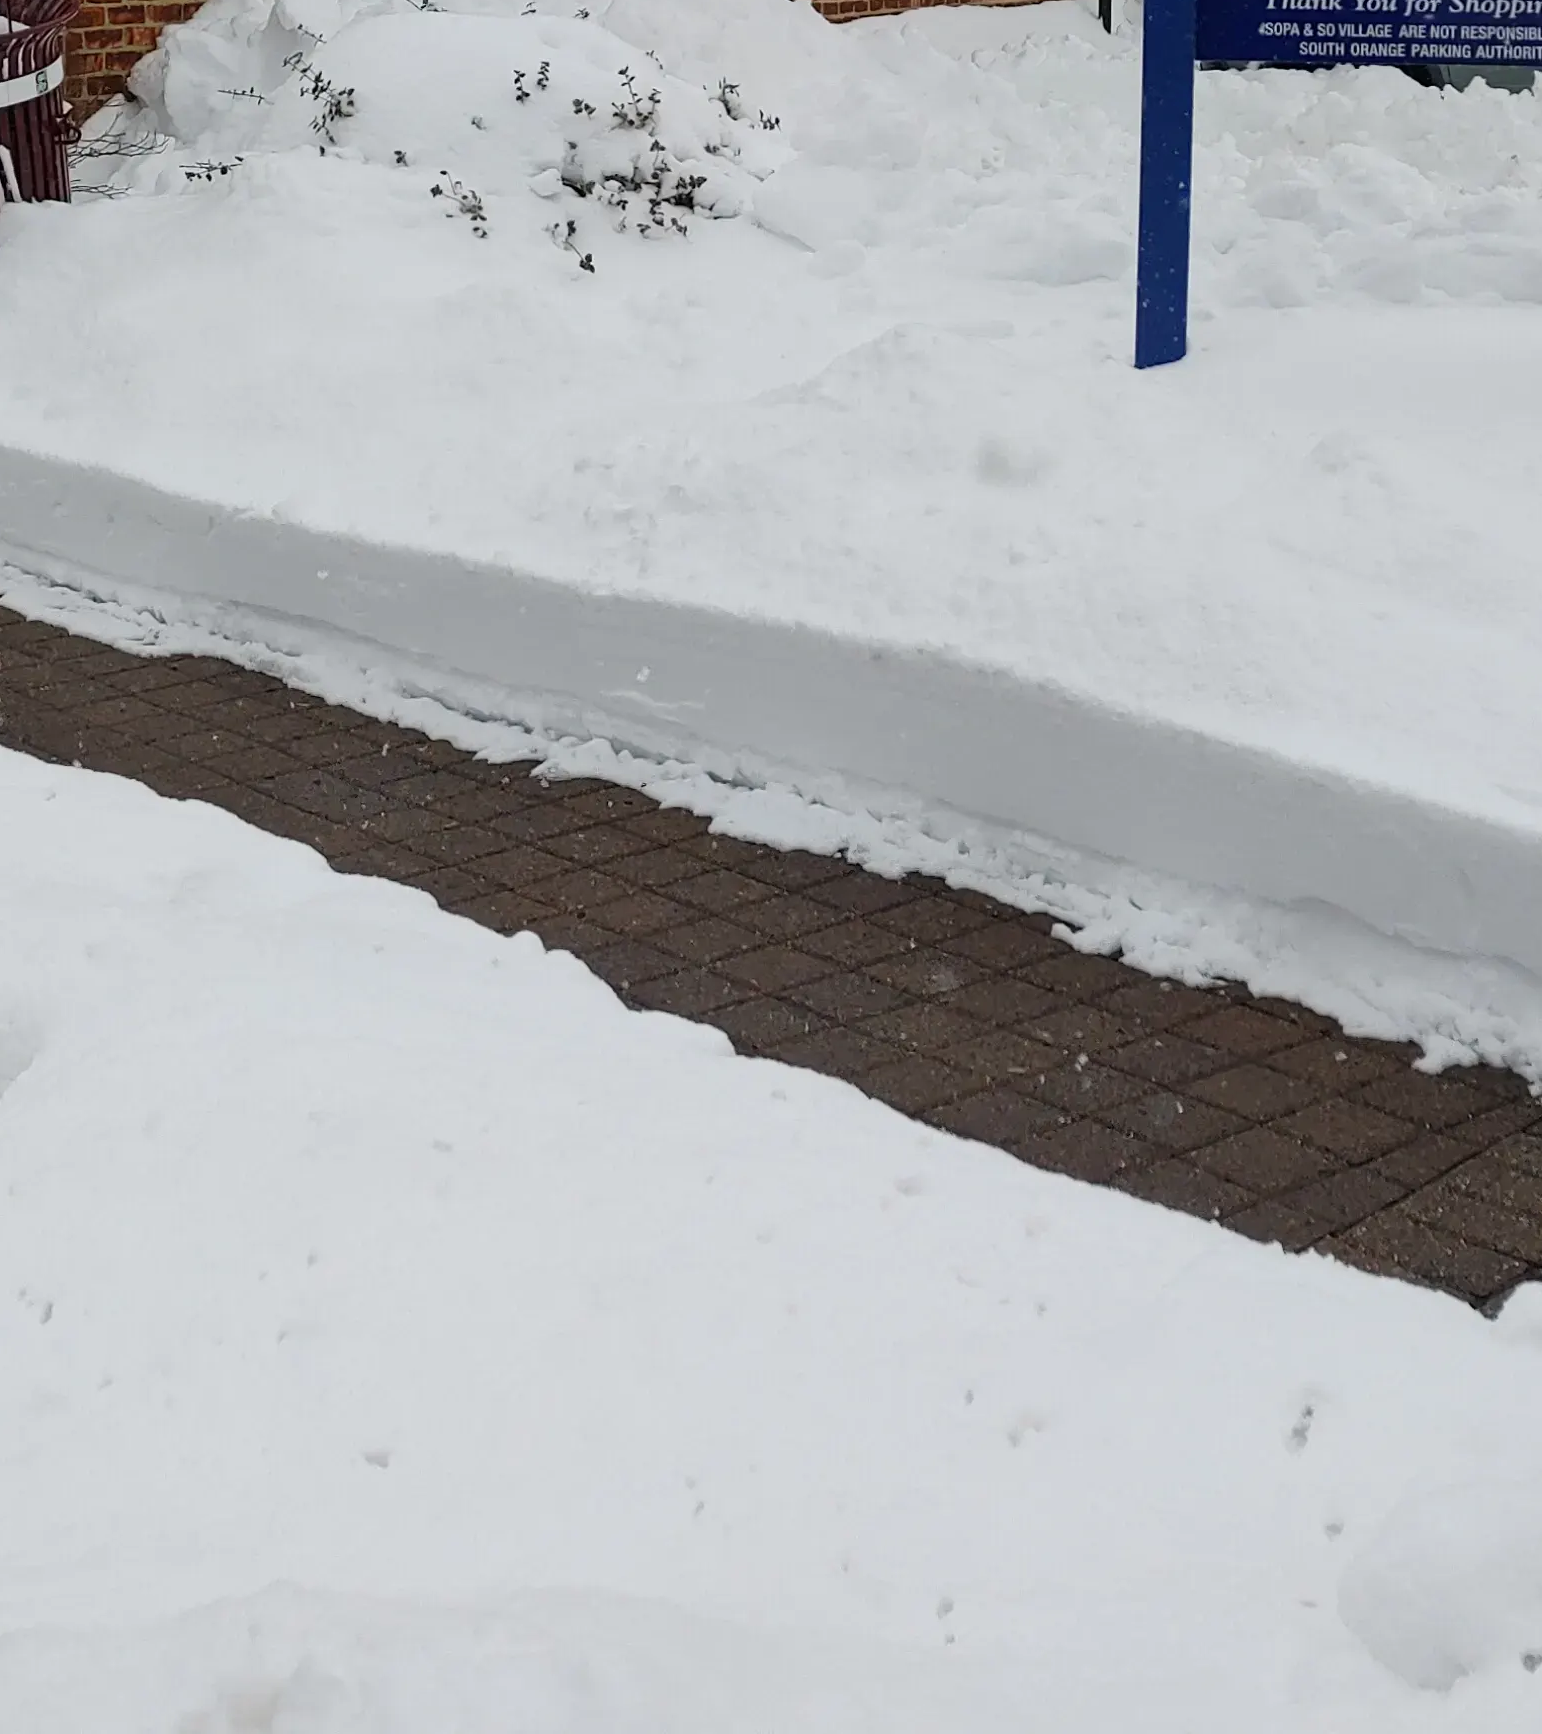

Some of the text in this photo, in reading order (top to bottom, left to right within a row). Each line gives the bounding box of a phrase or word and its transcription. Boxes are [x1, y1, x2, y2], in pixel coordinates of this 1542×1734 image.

[1303, 22, 1314, 36] &
[1317, 23, 1336, 36] SO
[1339, 23, 1393, 38] VILLAGE
[1399, 24, 1427, 39] ARE
[1430, 25, 1457, 39] NOT
[1299, 41, 1344, 56] SOUTH
[1350, 42, 1406, 57] ORANGE
[1411, 43, 1471, 59] PARKING
